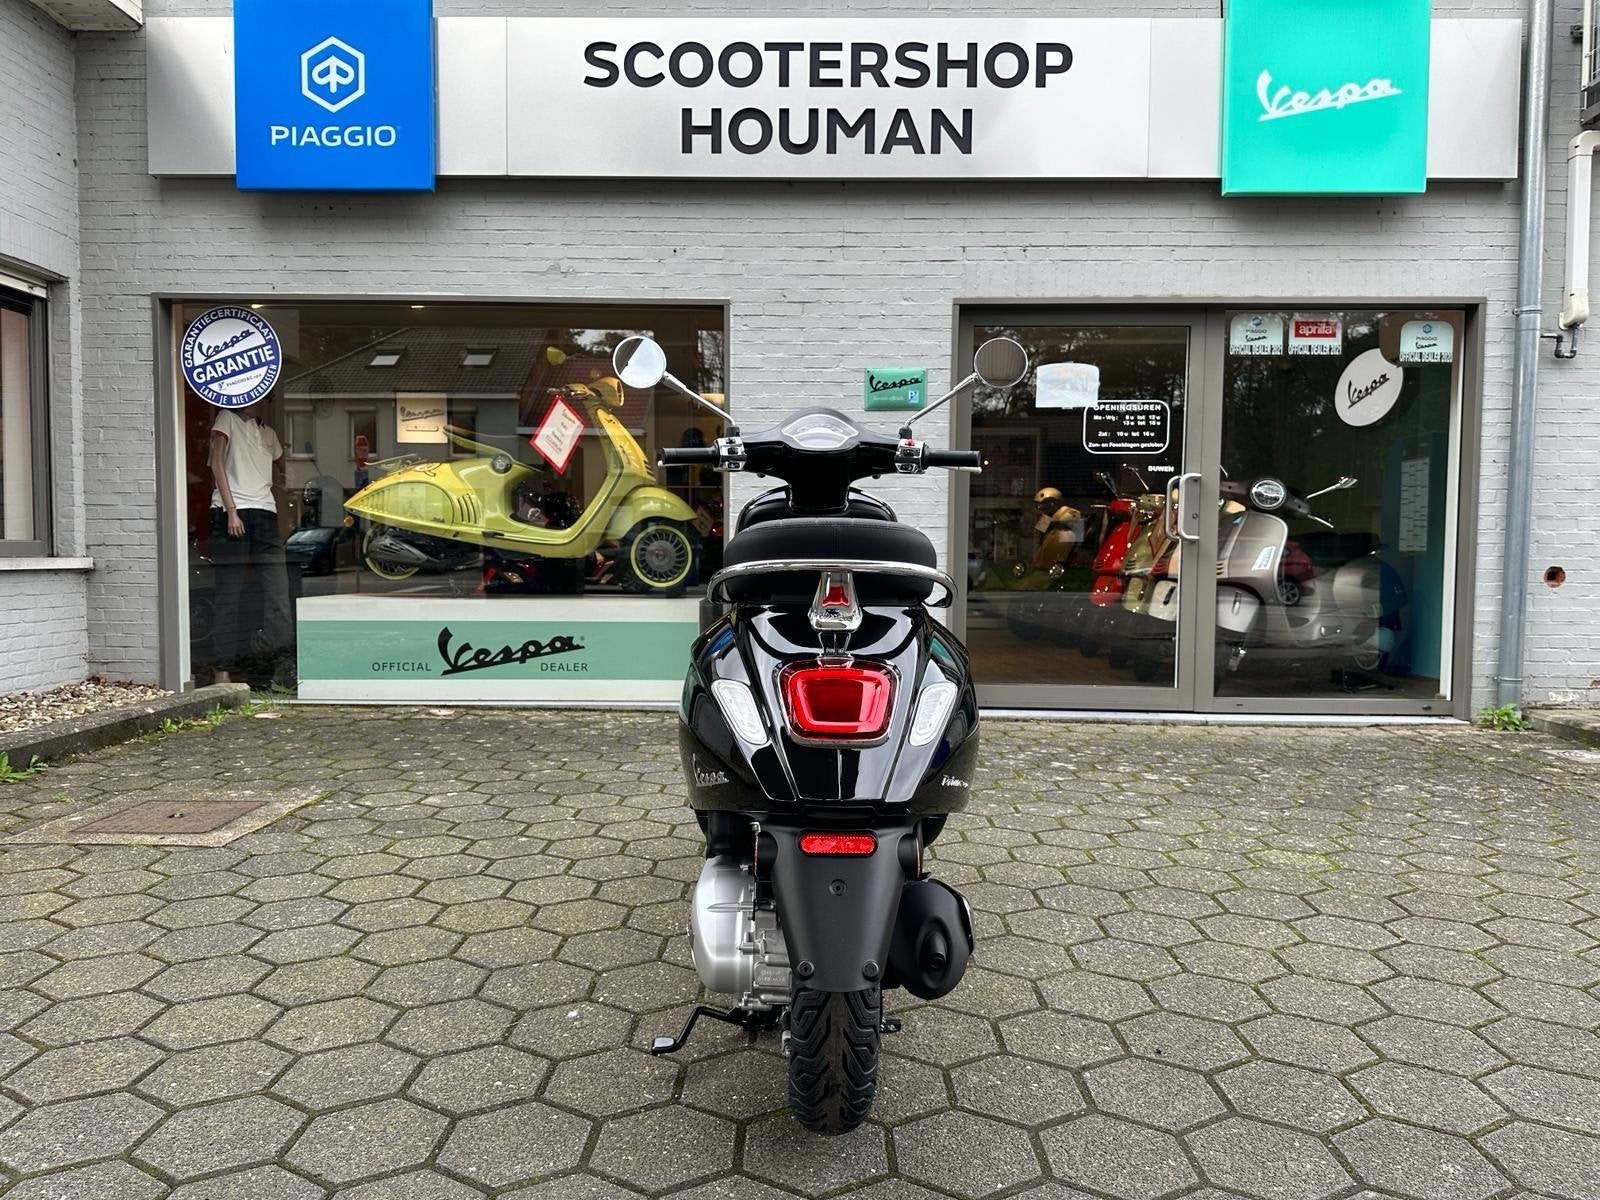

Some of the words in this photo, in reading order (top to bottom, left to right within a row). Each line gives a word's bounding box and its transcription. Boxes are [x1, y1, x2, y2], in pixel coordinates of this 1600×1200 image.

[583, 41, 1073, 88] SCOOTERSHOP
[1256, 69, 1402, 122] Vespa
[270, 125, 397, 147] PIAGGIO
[681, 107, 973, 155] HOUMAN
[184, 308, 274, 368] GARANTIECERTIFICAAT
[197, 329, 256, 362] Vespa
[1230, 344, 1251, 355] OFFICIAL
[1252, 344, 1270, 355] DEALER
[1288, 344, 1310, 355] OFFICIAL
[1311, 344, 1329, 355] DEALER
[192, 345, 275, 384] GARANTIE
[1400, 352, 1421, 362] OFFICIAL
[1422, 352, 1440, 362] DEALER
[200, 385, 216, 400] LAAT
[220, 396, 227, 404] JE
[232, 395, 249, 405] NIET
[250, 364, 278, 399] VERRASSEN
[869, 374, 923, 393] Vespa
[1348, 373, 1390, 408] Vespa
[371, 662, 432, 672] OFFICIAL
[437, 626, 585, 676] Vespa
[540, 662, 588, 672] DEALER
[692, 753, 730, 787] Vespa
